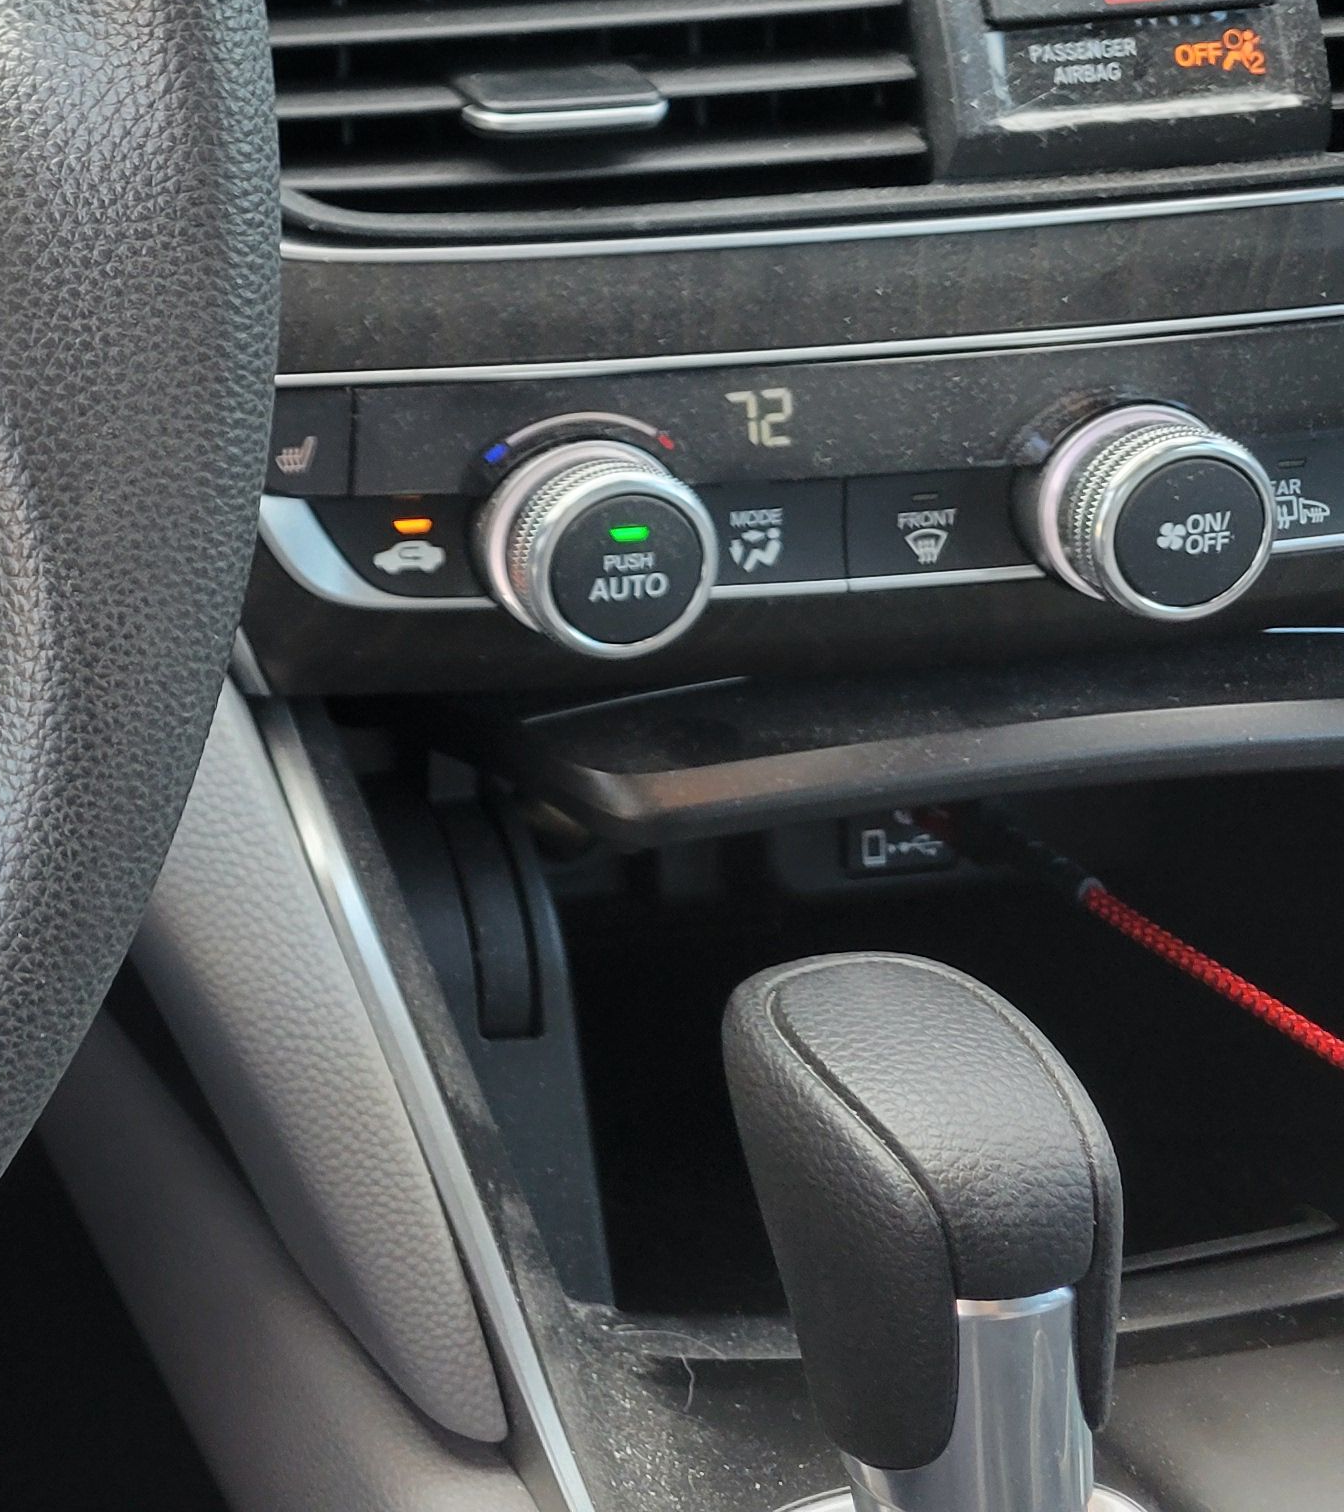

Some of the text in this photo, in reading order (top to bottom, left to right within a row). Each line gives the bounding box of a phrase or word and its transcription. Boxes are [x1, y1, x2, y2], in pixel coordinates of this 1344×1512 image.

[1028, 37, 1138, 64] PASSENGER
[1174, 43, 1223, 68] OFF
[1053, 62, 1123, 86] AIRBAG
[725, 388, 794, 448] 72
[729, 506, 783, 529] MODE
[897, 508, 958, 530] FRONT
[1186, 510, 1232, 534] ON/
[1185, 530, 1231, 556] OFF
[603, 551, 654, 572] PUSH
[588, 572, 669, 604] AUTO
